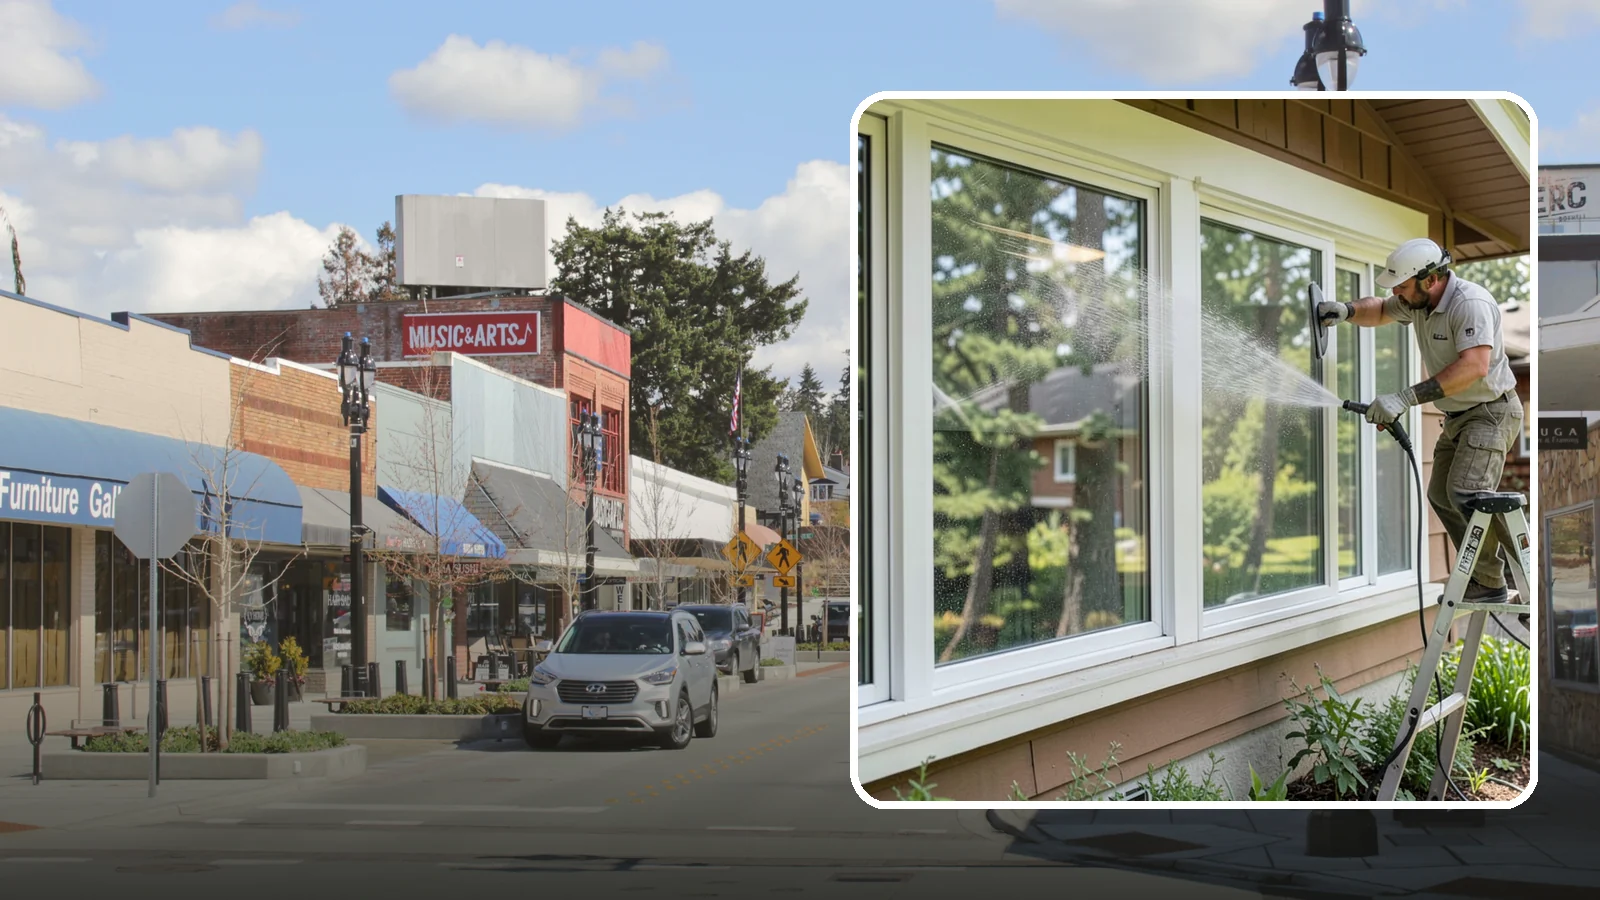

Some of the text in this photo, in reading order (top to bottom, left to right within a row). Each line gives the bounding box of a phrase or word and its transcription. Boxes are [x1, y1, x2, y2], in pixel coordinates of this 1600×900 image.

[409, 323, 519, 348] MUSIC&ARTS
[0, 471, 122, 519] Furniture Gal
